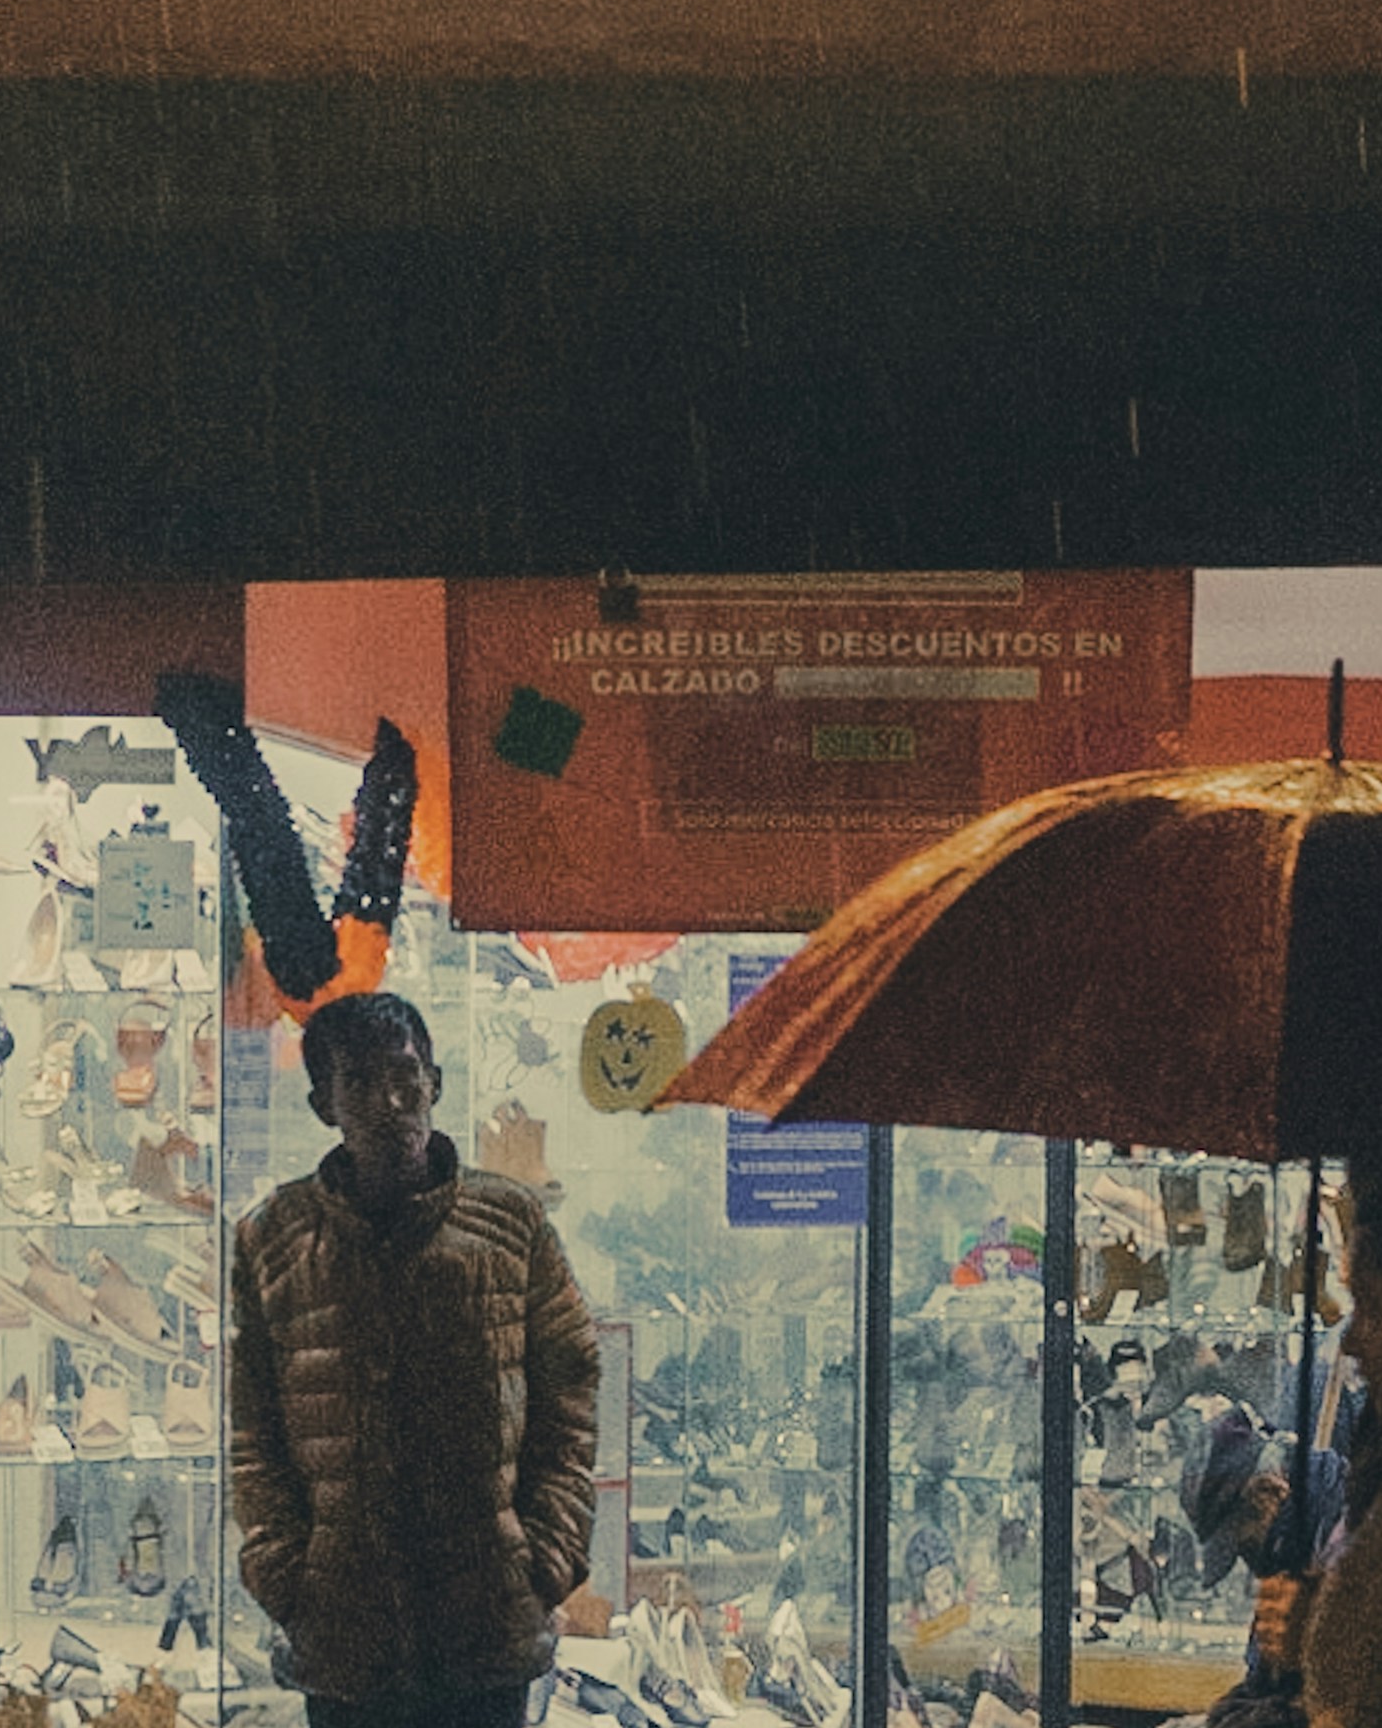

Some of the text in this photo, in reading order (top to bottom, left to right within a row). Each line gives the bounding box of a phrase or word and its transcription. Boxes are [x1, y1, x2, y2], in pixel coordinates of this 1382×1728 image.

[819, 630, 1062, 658] DESCUENTOS
[1074, 629, 1123, 658] EN
[590, 668, 761, 696] CALZADO
